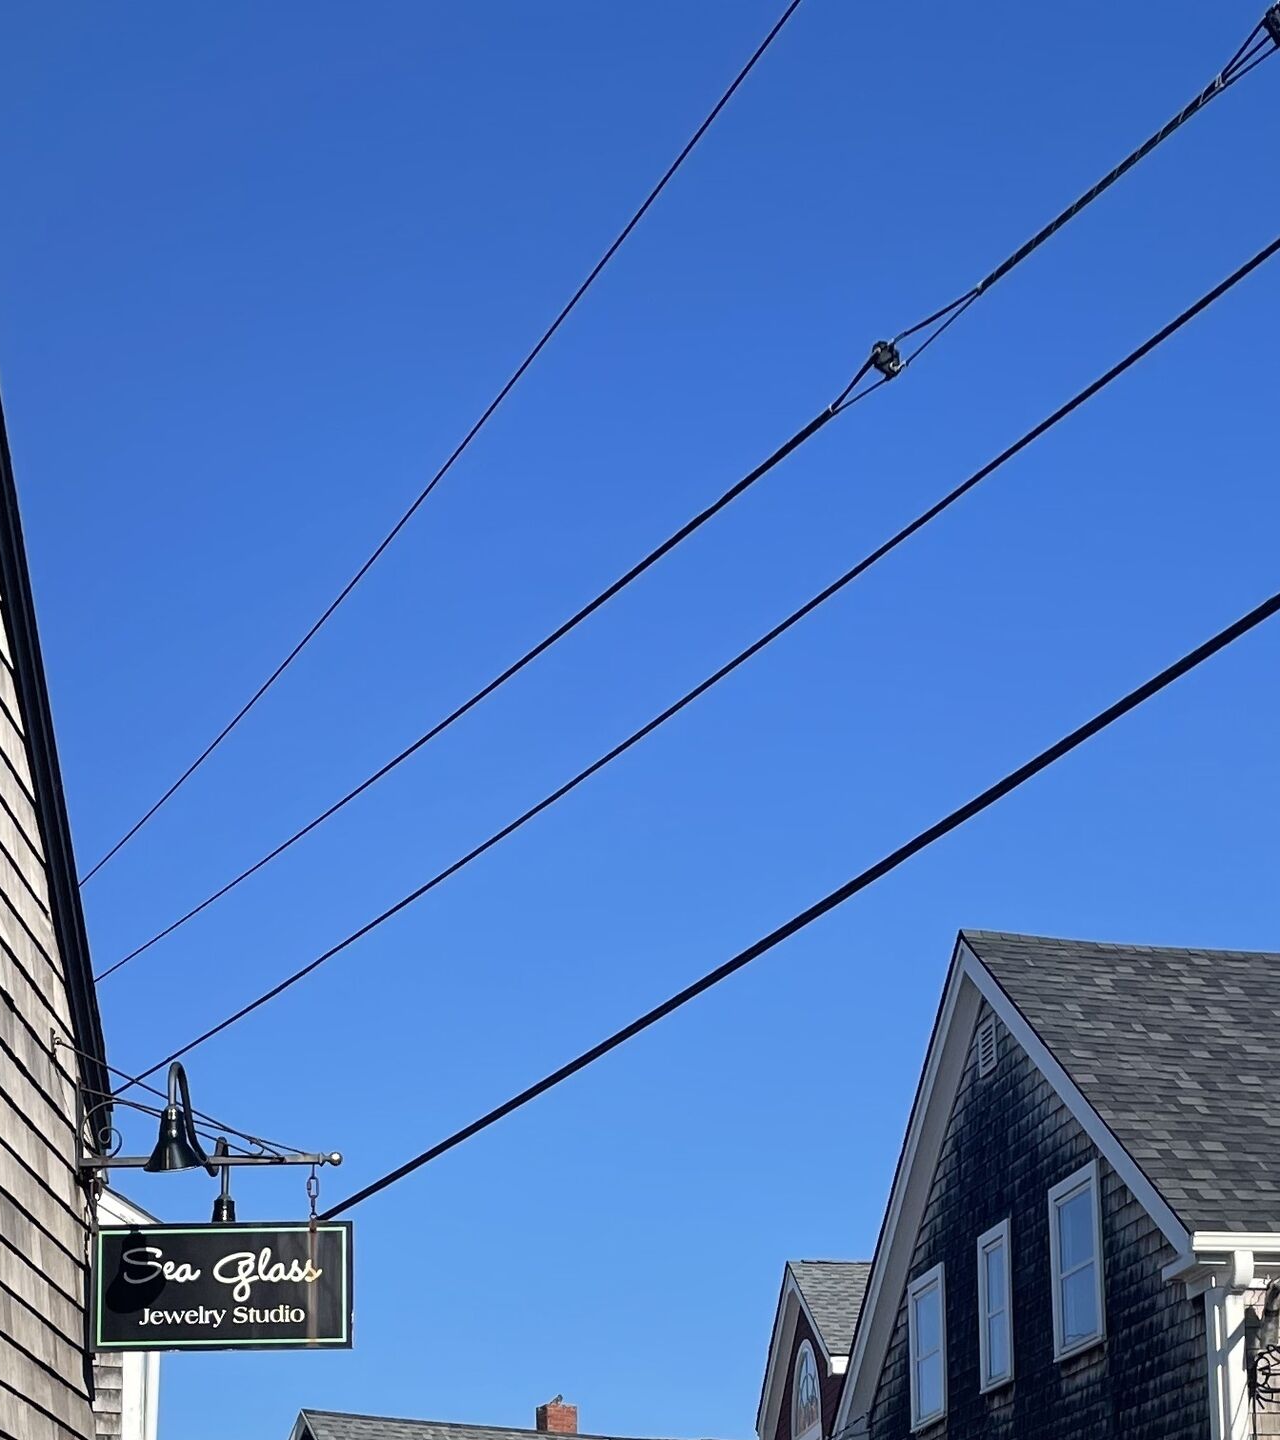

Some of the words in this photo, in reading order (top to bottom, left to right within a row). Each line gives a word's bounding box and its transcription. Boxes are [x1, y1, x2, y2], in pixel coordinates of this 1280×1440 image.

[122, 1246, 201, 1285] Sea
[213, 1247, 323, 1302] Glass
[138, 1305, 227, 1328] Jewelry
[232, 1304, 306, 1325] Studio
